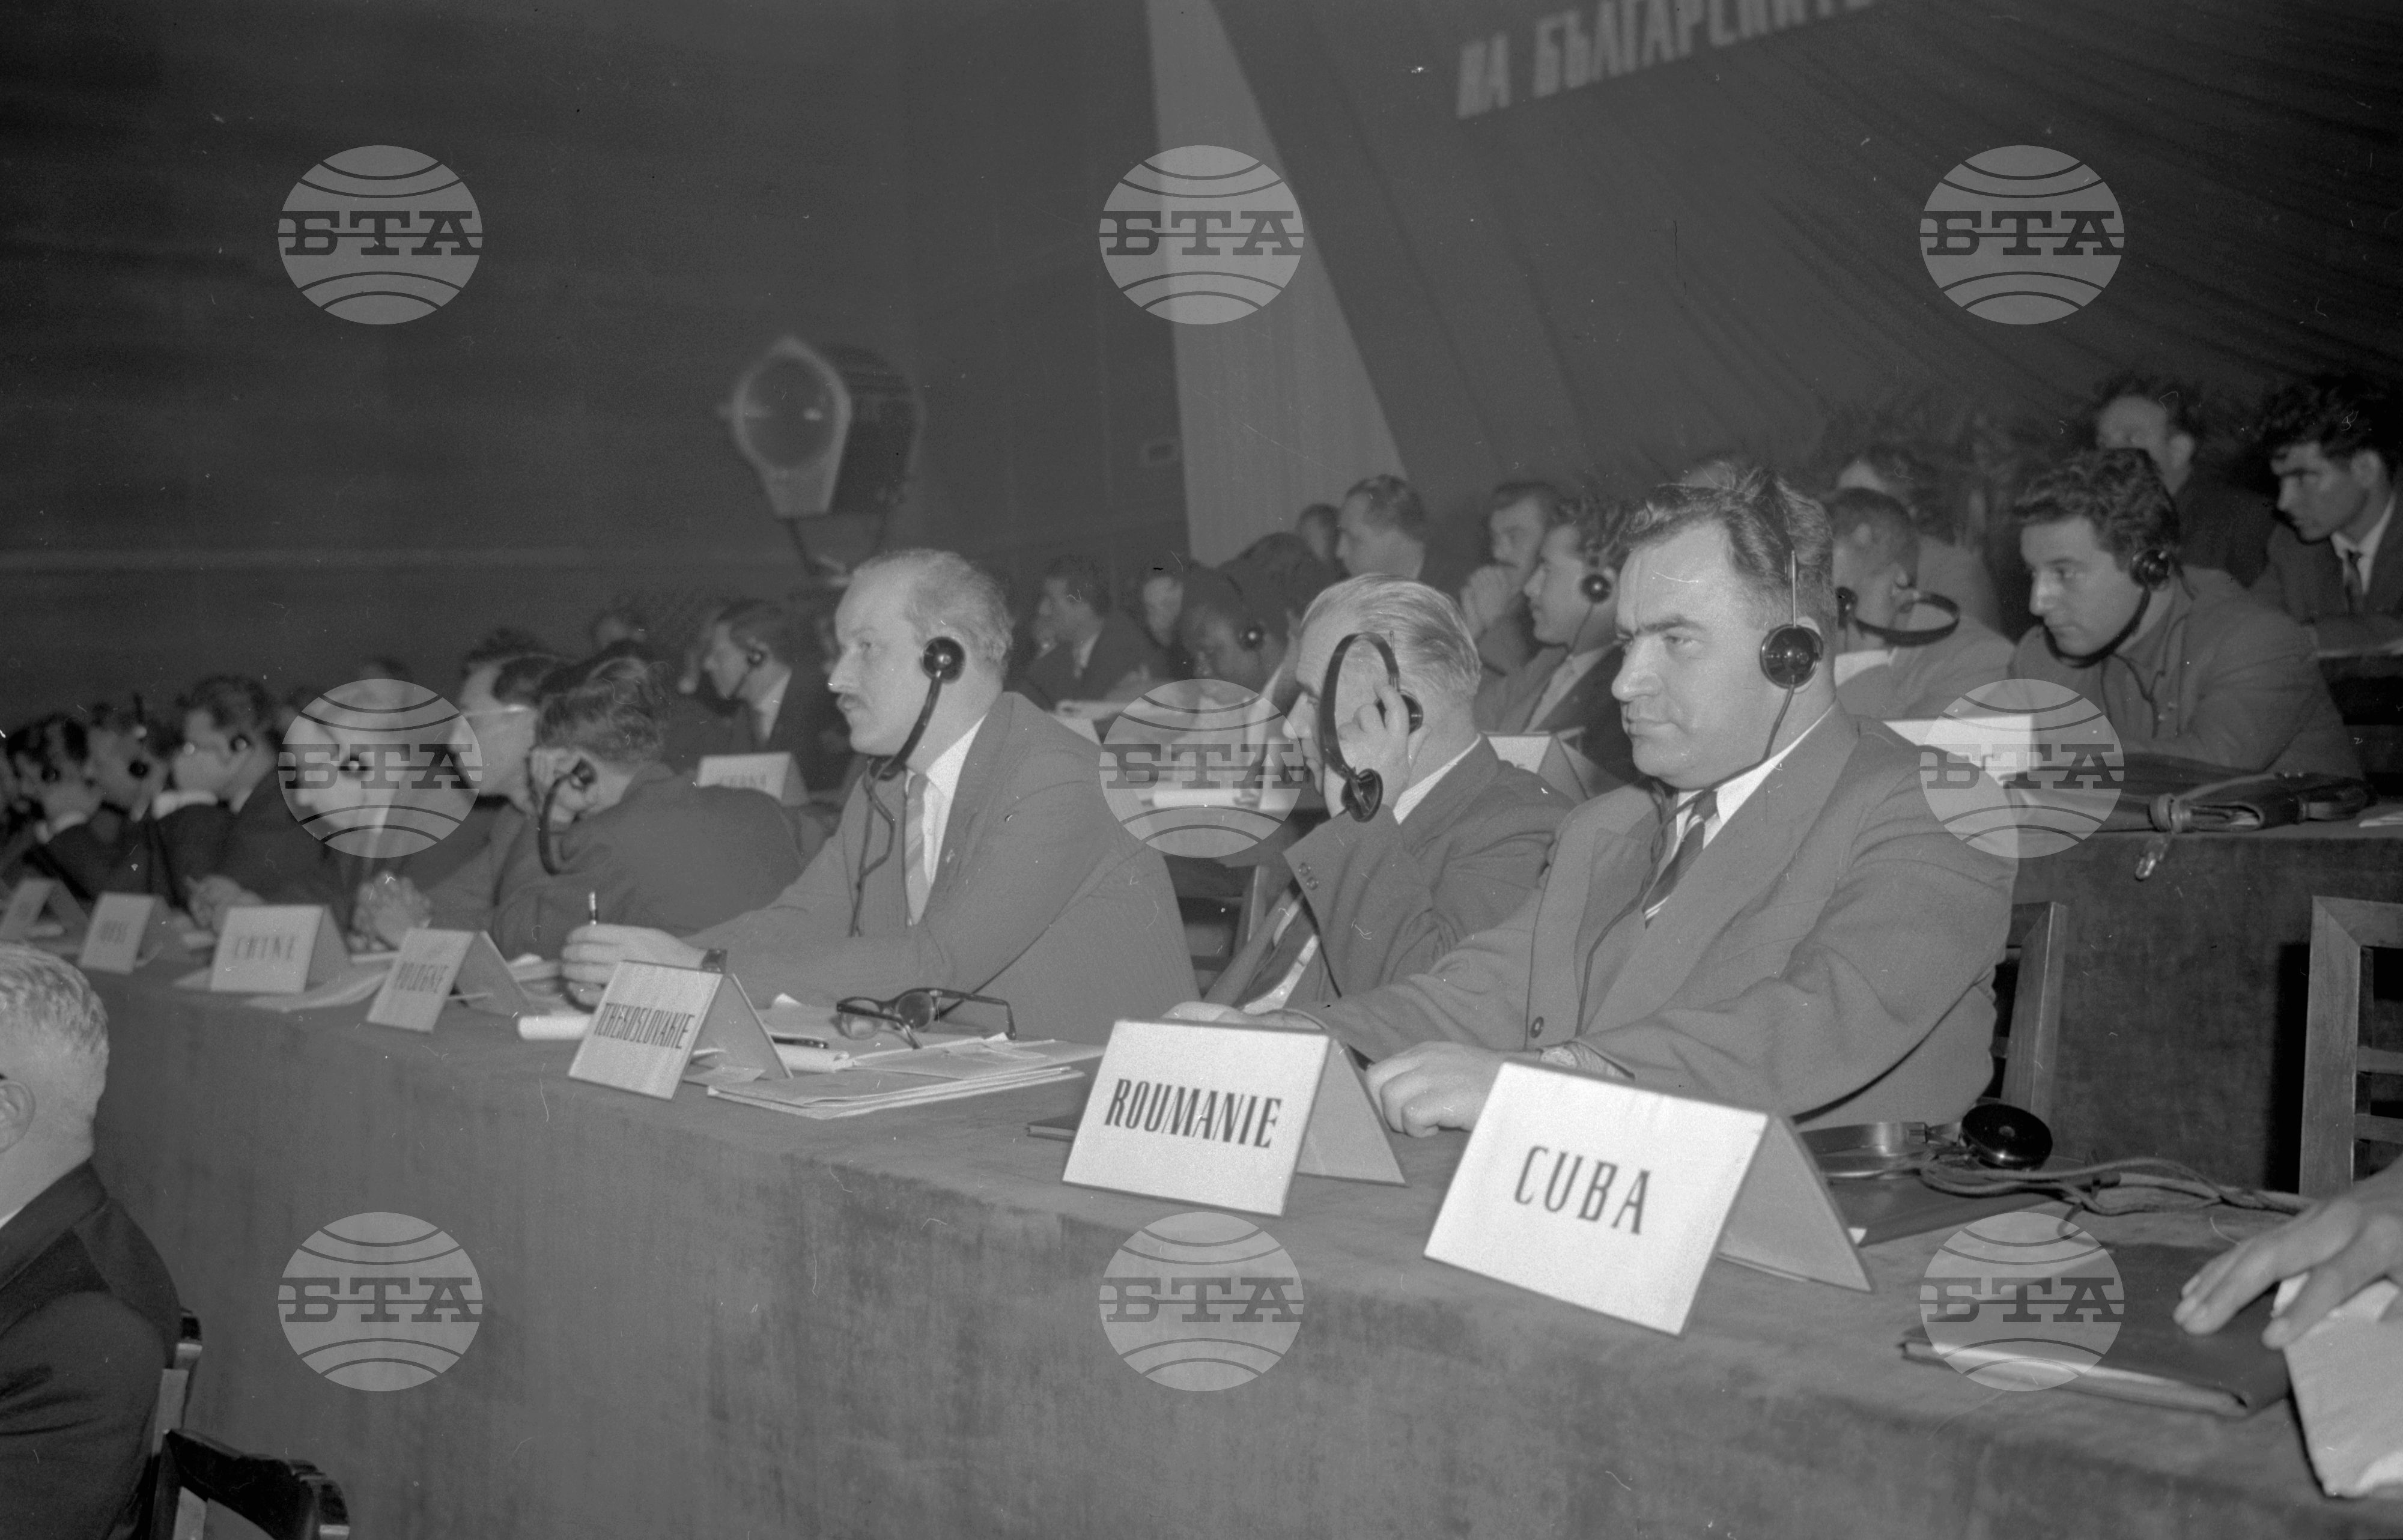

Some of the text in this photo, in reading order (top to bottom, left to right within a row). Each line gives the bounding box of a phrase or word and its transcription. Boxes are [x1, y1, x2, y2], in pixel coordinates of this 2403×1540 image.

[1533, 0, 1876, 98] БЪЛГАРС
[594, 1002, 695, 1049] TCHEKOSLOVAKIE
[1104, 1078, 1282, 1148] ROUMANIE
[1514, 1145, 1651, 1235] CUBA
